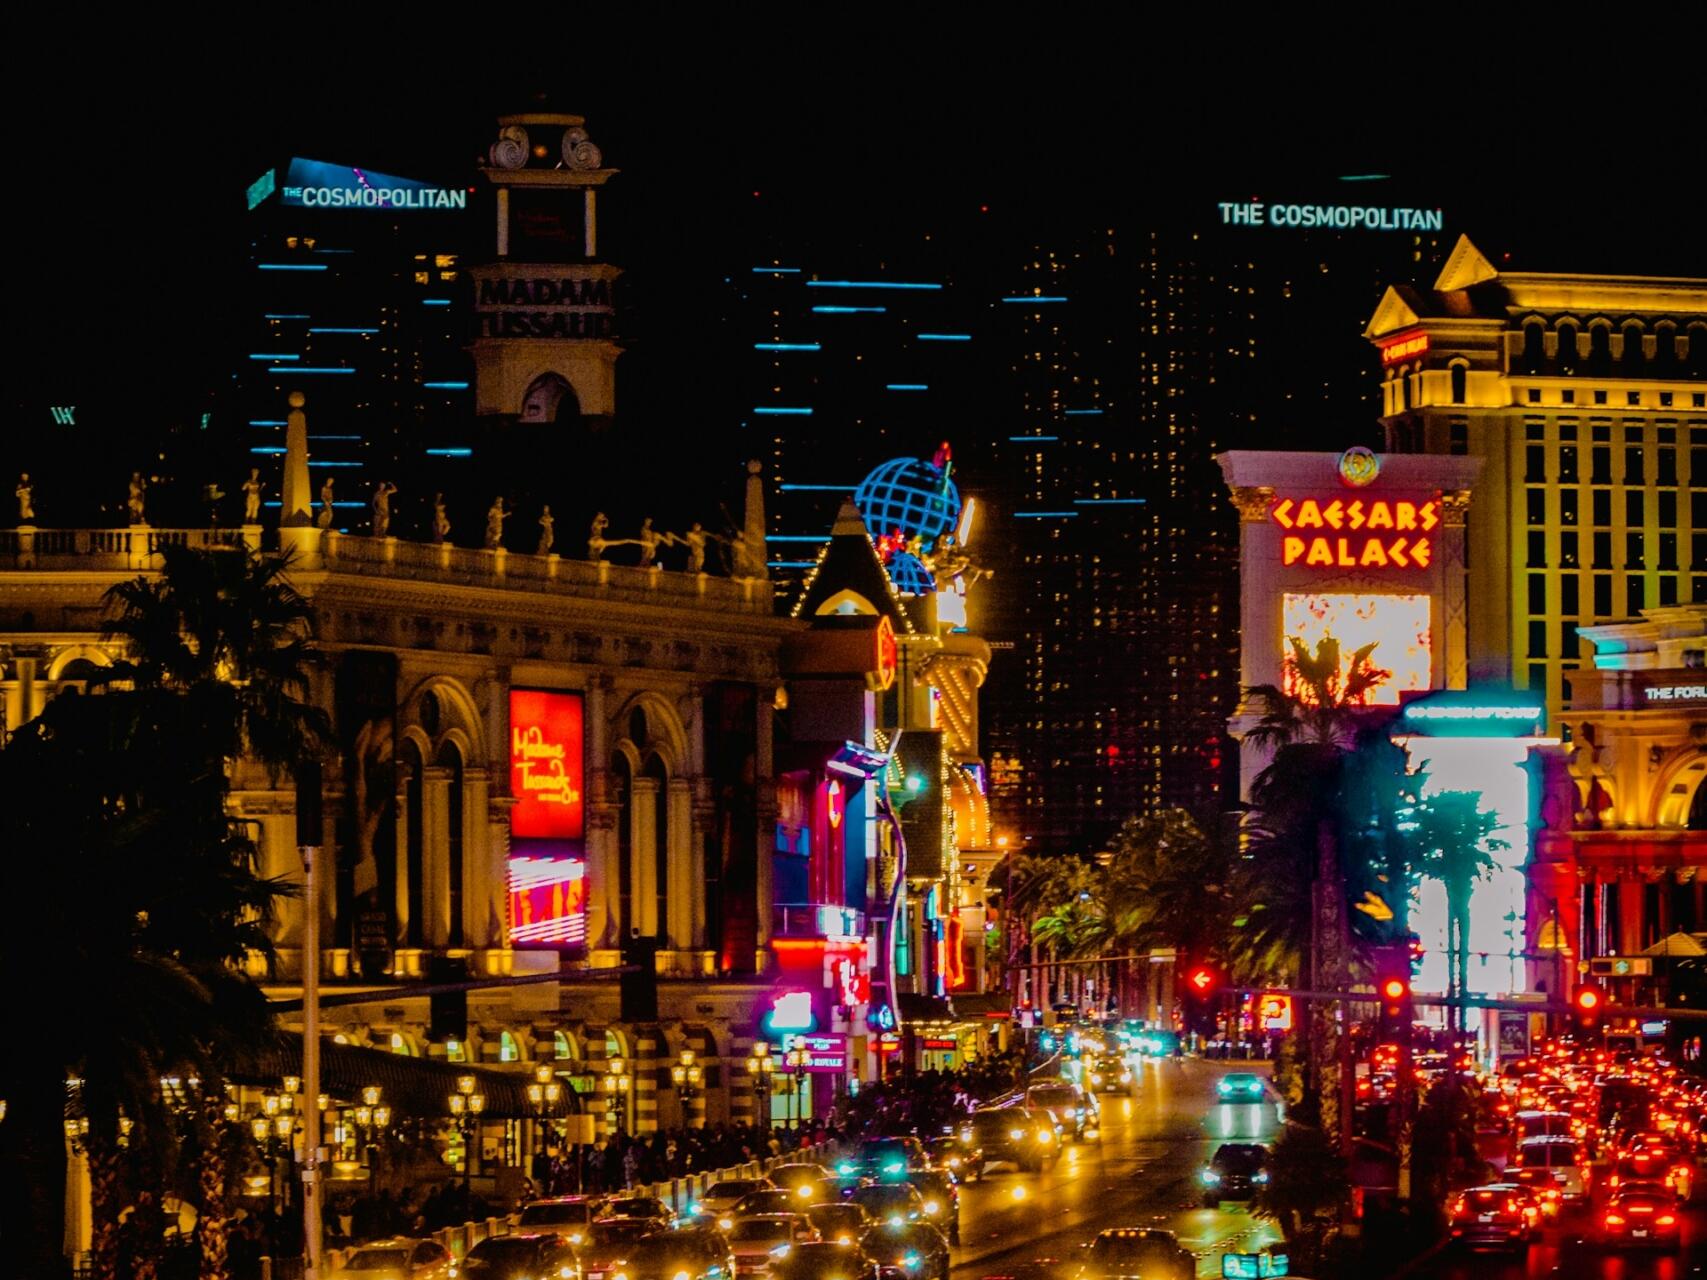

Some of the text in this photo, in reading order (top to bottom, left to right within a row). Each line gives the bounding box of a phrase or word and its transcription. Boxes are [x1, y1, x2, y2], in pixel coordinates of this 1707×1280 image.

[283, 187, 466, 209] THE COSMOPOLITAN
[1218, 202, 1443, 231] THE COSMOPOLITAN
[1273, 500, 1439, 531] CAESARS
[1283, 537, 1432, 568] PALACE
[1644, 687, 1673, 700] THE
